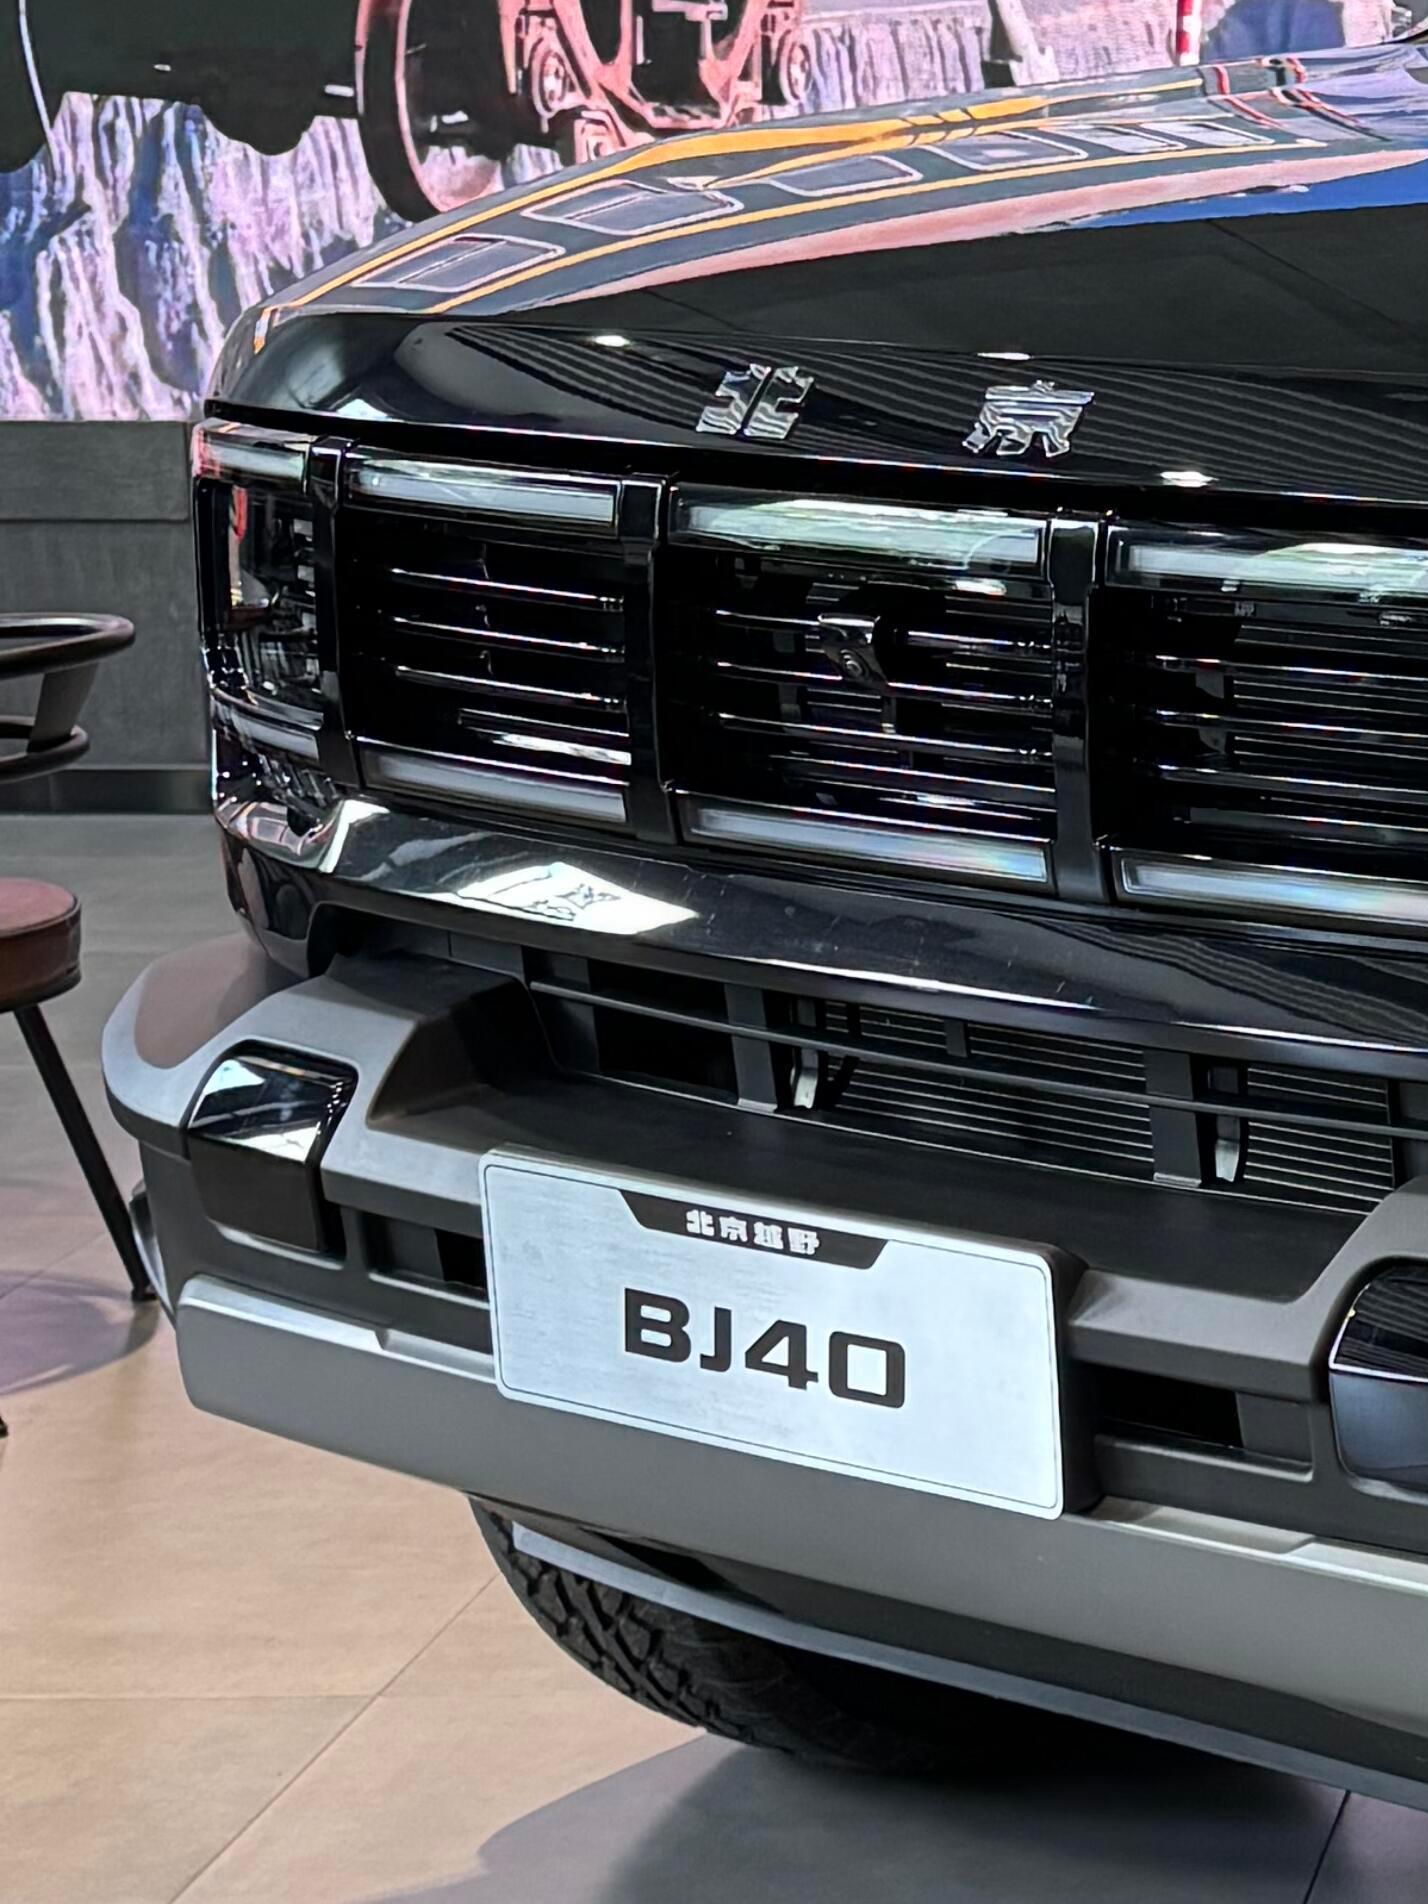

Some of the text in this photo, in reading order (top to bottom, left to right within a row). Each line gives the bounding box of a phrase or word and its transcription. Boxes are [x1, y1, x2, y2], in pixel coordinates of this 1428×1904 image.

[685, 1207, 821, 1258] 北京越野
[623, 1287, 907, 1409] BJ40
